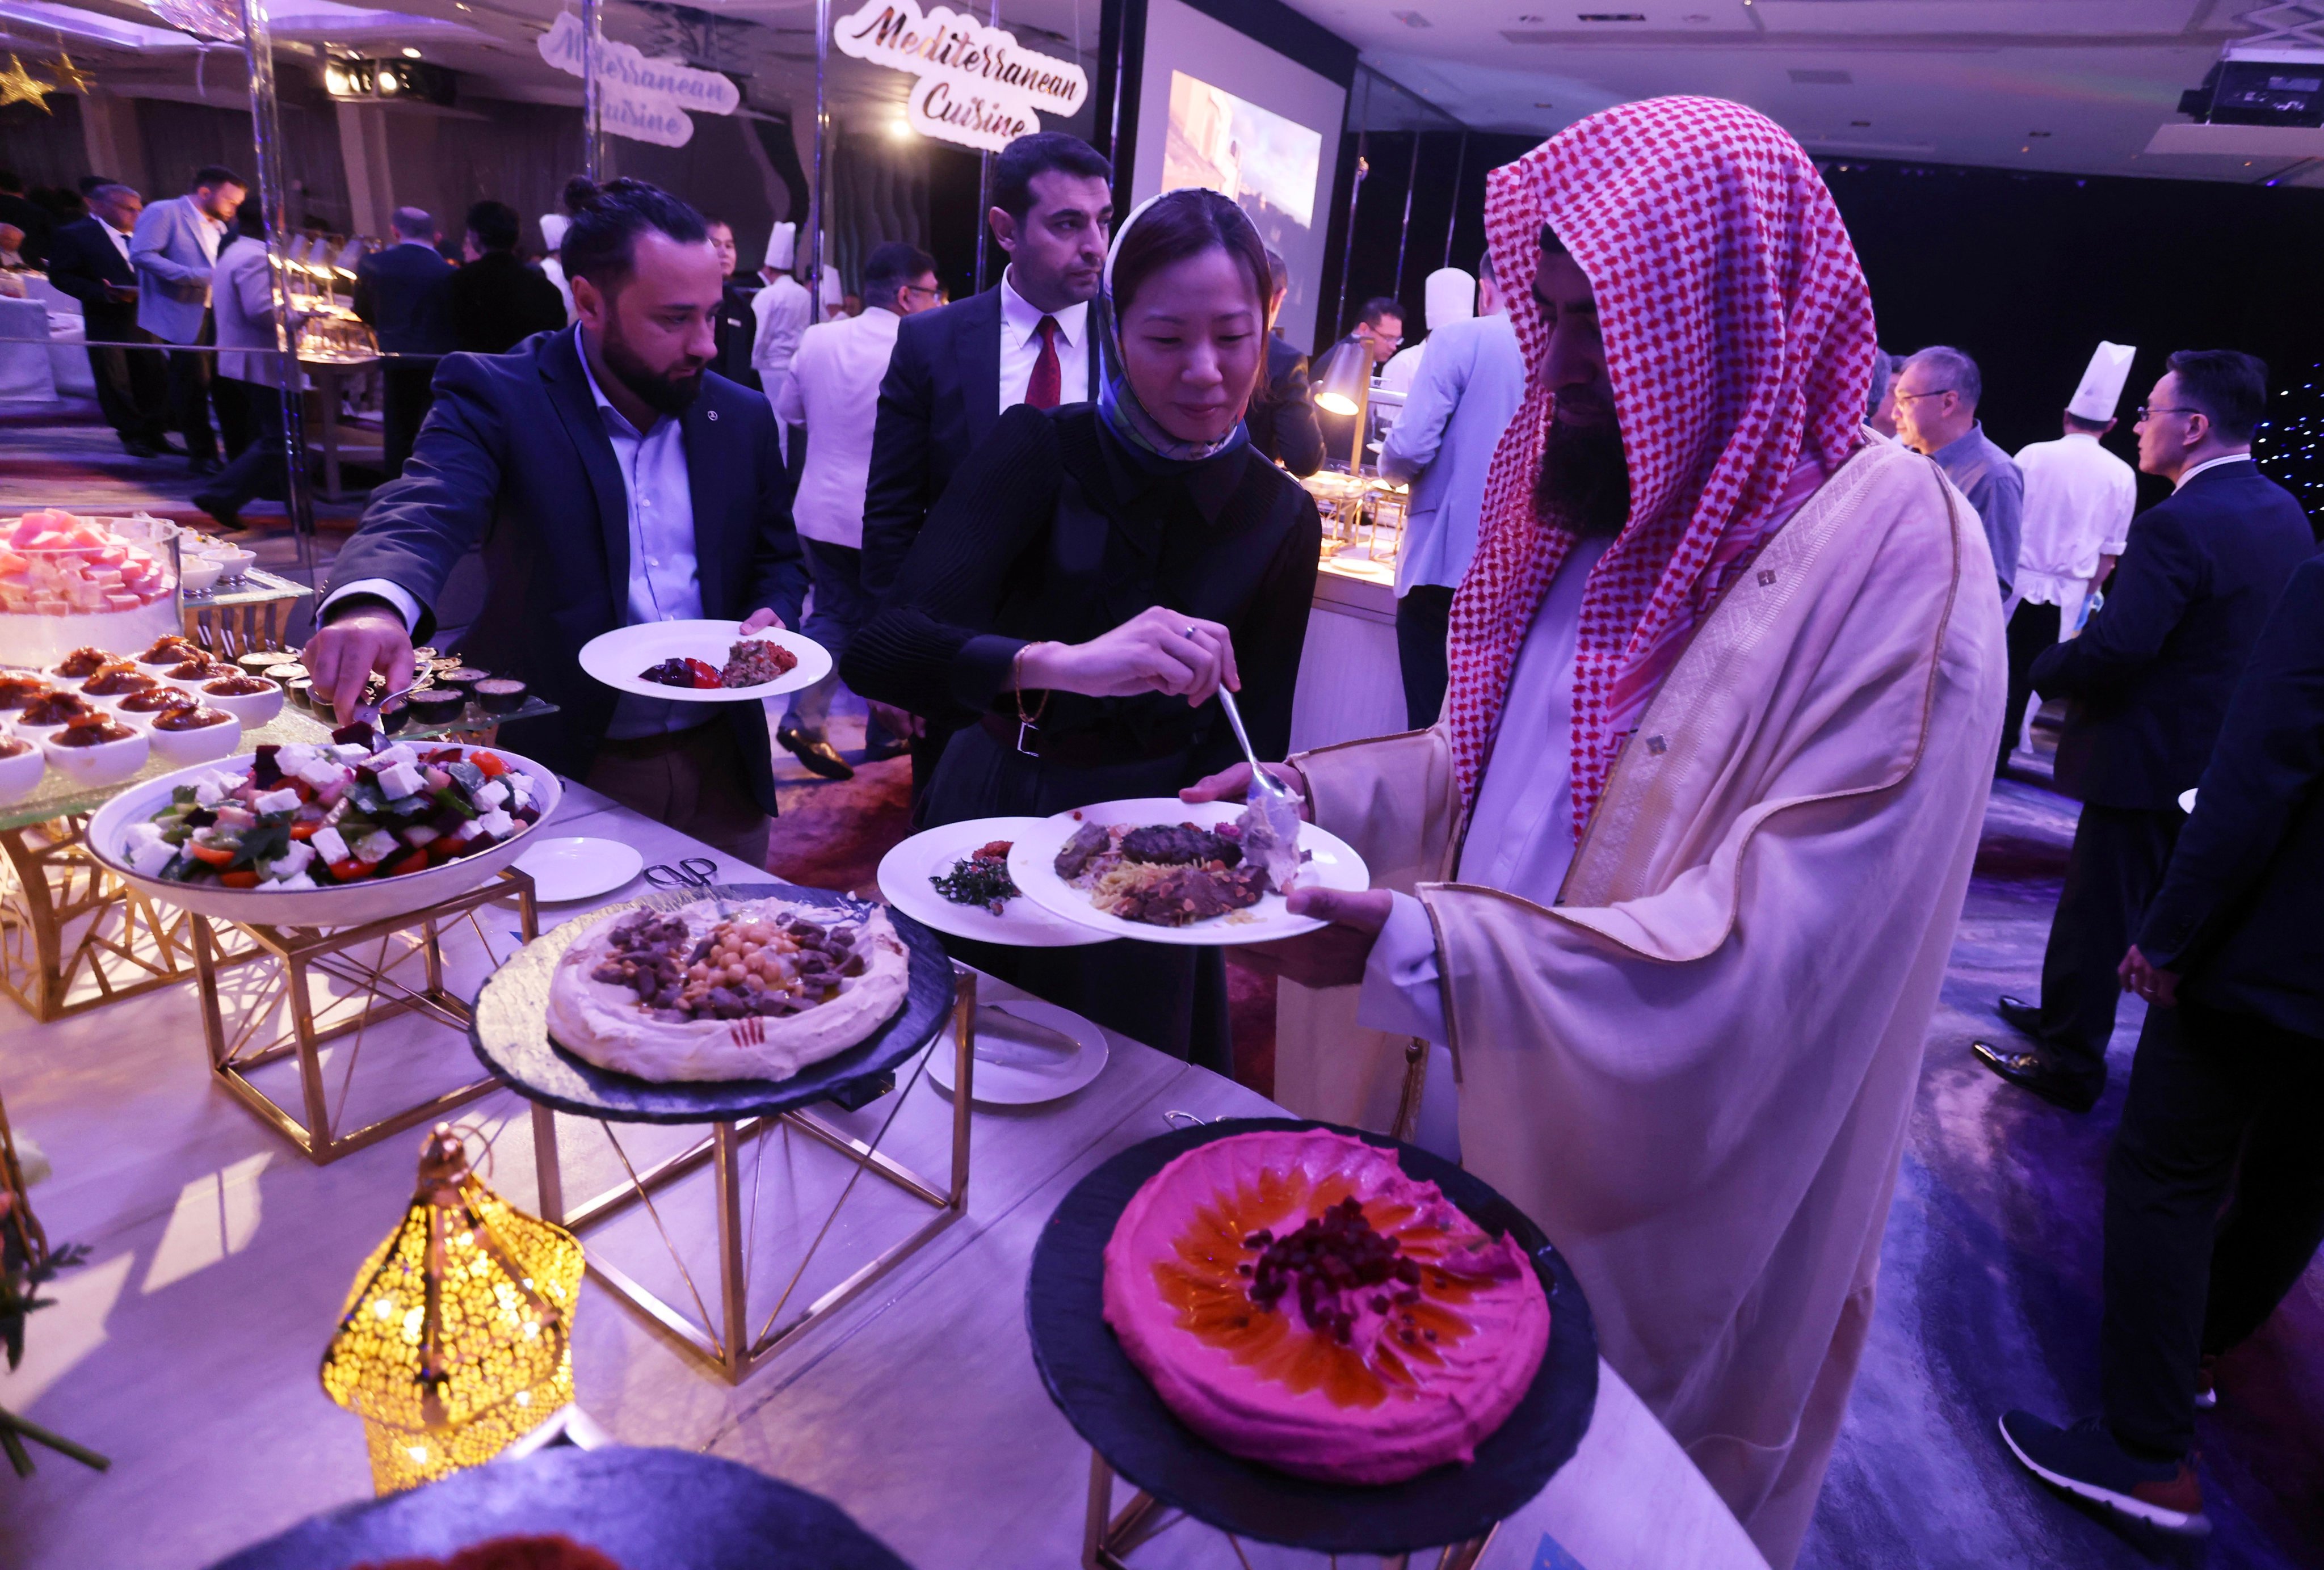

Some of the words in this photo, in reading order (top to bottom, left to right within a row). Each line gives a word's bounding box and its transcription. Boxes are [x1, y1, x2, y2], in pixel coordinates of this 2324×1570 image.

[550, 26, 724, 102] Mterranean
[852, 6, 1078, 101] Mediterranean
[600, 95, 682, 136] uisine
[923, 83, 1028, 137] Cuisine
